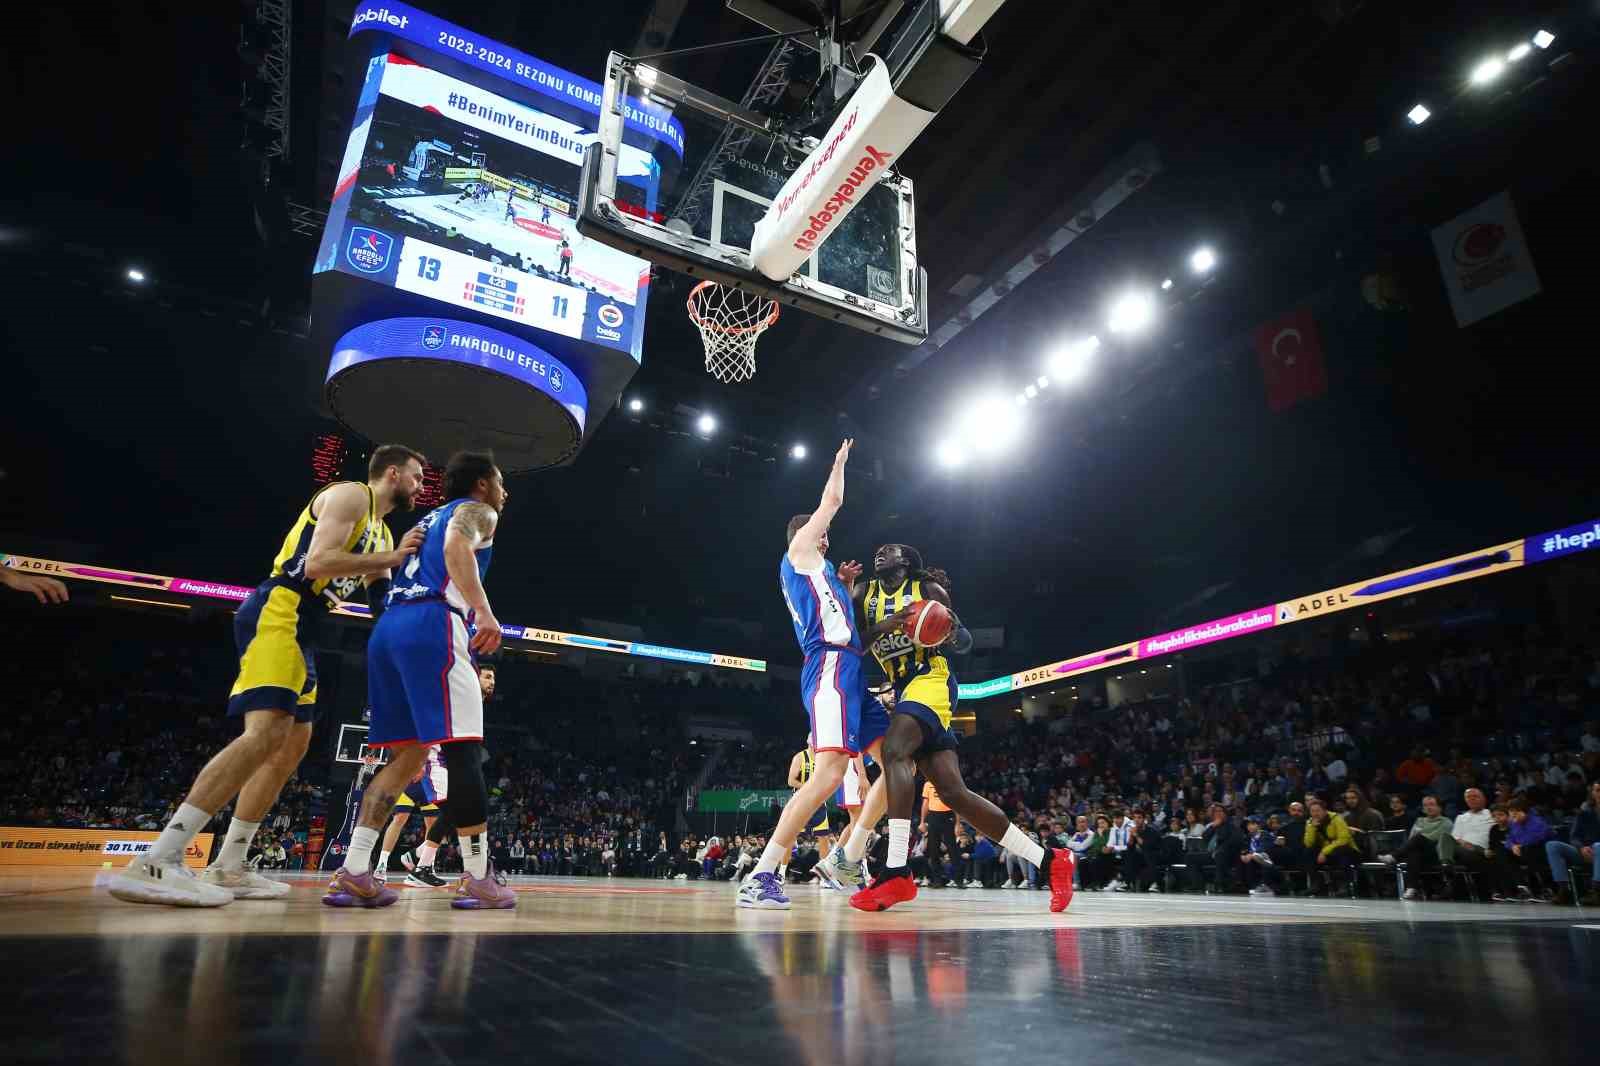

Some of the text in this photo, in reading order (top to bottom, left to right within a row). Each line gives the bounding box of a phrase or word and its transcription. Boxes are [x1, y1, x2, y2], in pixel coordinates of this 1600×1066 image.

[438, 31, 512, 71] 2023-2024
[515, 62, 564, 91] SEZONU
[777, 105, 860, 222] Yemeksepeti
[793, 144, 894, 252] Yemeksepeti
[417, 255, 442, 281] 13
[552, 295, 569, 319] 11
[450, 334, 546, 377] ANADOLU EFES
[21, 560, 62, 573] ADEL
[1297, 593, 1349, 614] ADEL
[535, 632, 561, 641] ADEL
[721, 657, 743, 666] ADEL
[1024, 670, 1052, 683] ADEL
[1, 841, 14, 849] VE
[106, 843, 120, 851] 30
[122, 843, 132, 851] TL
